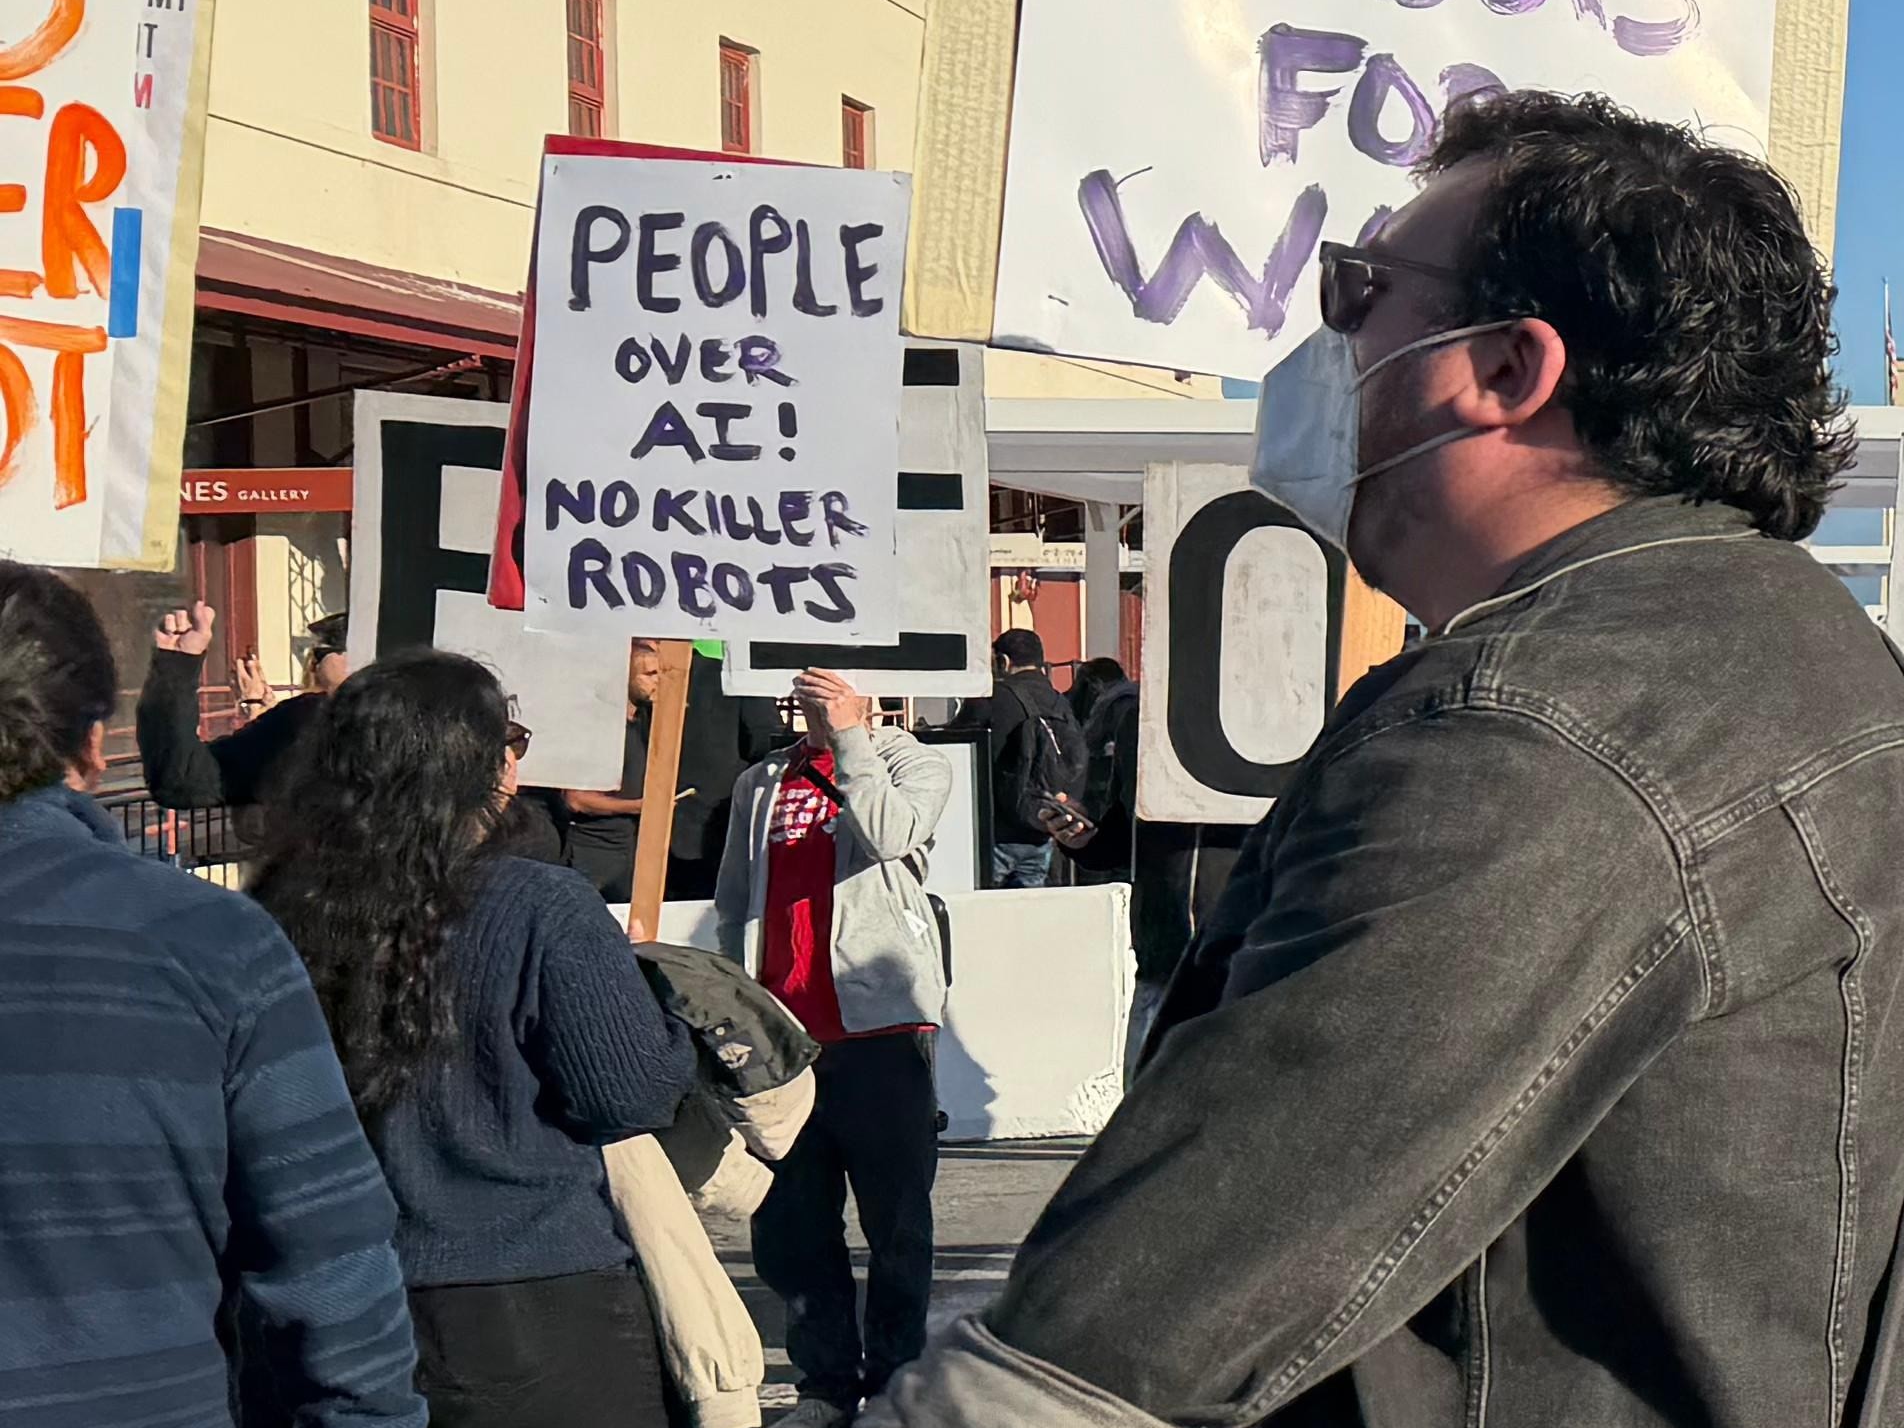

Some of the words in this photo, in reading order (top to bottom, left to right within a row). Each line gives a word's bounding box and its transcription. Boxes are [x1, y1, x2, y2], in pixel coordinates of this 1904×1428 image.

[569, 204, 885, 317] PEOPLE
[616, 333, 798, 387] OVER
[630, 402, 797, 461] AI!
[238, 489, 310, 502] GALLERY
[545, 478, 639, 532] NO
[655, 483, 869, 547] KILLER
[568, 538, 858, 622] ROBOTS
